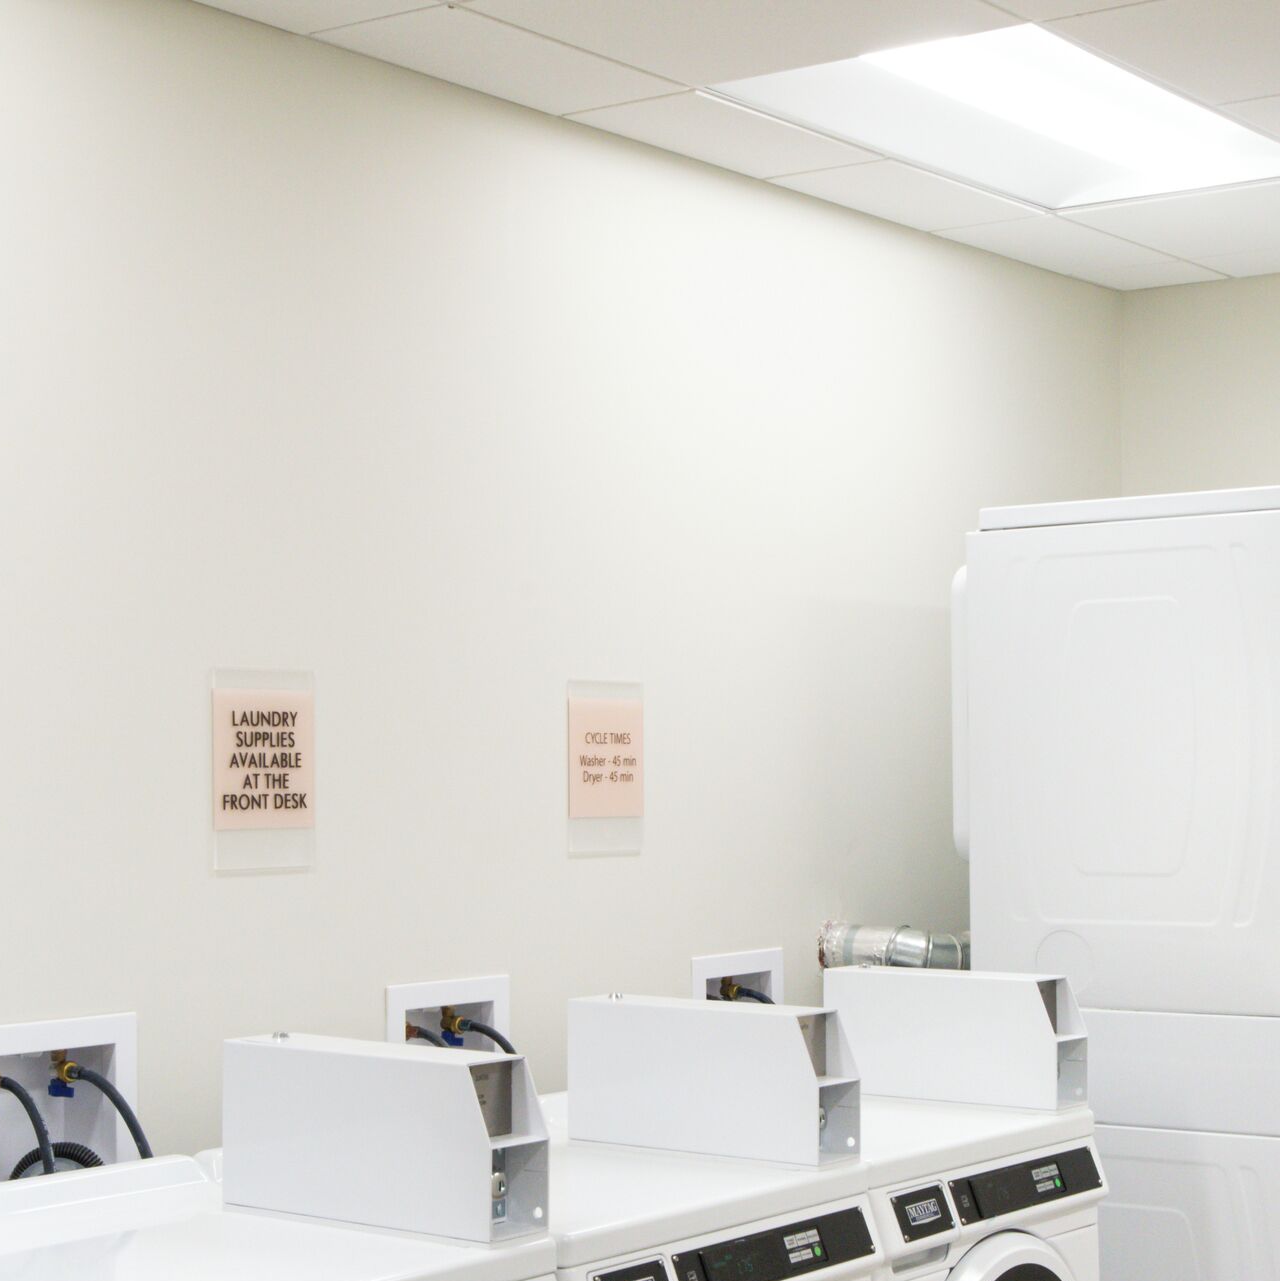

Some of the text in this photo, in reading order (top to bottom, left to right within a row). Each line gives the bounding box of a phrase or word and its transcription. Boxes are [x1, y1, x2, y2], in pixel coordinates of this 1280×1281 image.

[232, 710, 298, 727] LAUNDRY
[235, 731, 296, 748] SUPPLIES
[584, 732, 631, 745] CYCLE TIMES
[229, 752, 302, 769] AVAILABLE
[579, 754, 606, 767] Washer
[612, 755, 621, 767] 45
[622, 755, 637, 767] min
[243, 773, 290, 789] AT THE
[583, 770, 603, 785] Dryer
[609, 771, 618, 783] 45
[619, 771, 634, 783] min
[222, 792, 308, 811] FRONT DESK
[908, 1201, 938, 1217] MAYTAG
